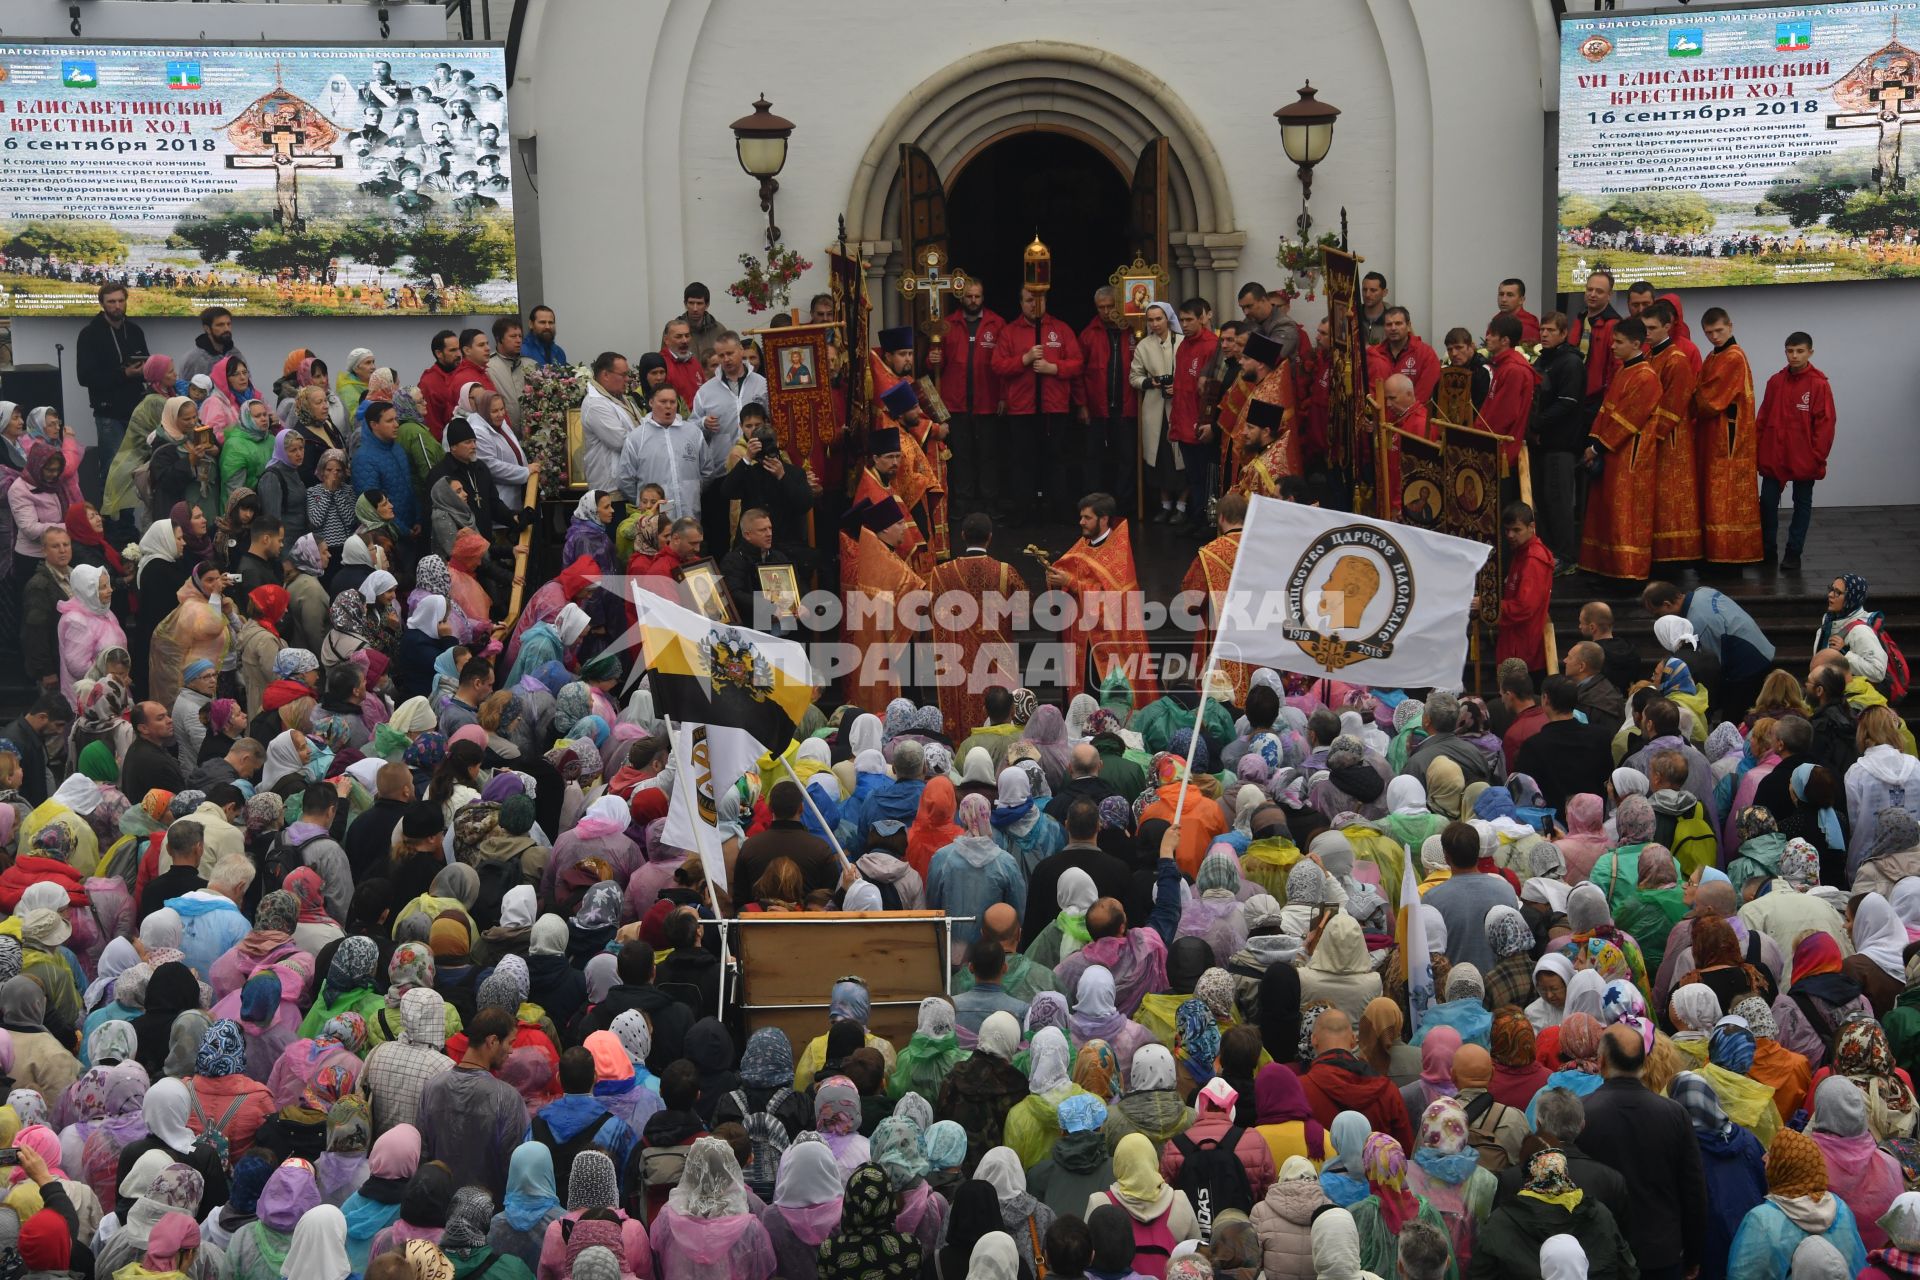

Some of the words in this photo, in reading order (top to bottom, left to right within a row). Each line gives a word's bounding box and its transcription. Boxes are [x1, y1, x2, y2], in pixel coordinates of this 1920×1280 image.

[1576, 22, 1594, 30] ПО
[1598, 15, 1716, 30] БЛАГОСЛОВЕНИЮ
[1720, 8, 1822, 23] МИТРОПОЛИТА
[1827, 2, 1918, 16] КРУТИЦКОГО
[111, 50, 209, 58] МИТРОПОЛИТА
[1618, 58, 1831, 87] ЕЛИСАВЕТИНСКИЙ
[1610, 83, 1734, 106] КРЕСТНЫЙ
[1746, 82, 1796, 100] ХОД
[17, 98, 222, 116] ЕЛИСАВЕТИНСКИЙ
[1588, 110, 1616, 124] 16
[1624, 104, 1746, 122] сентября
[1756, 100, 1820, 116] 2018
[10, 117, 132, 134] КРЕСТНЫЙ
[146, 120, 192, 135] ХОД
[1610, 130, 1664, 138] столетию
[1666, 124, 1750, 137] мученической
[1753, 124, 1806, 132] кончины
[27, 138, 148, 154] сентября
[156, 138, 216, 152] 2018
[1610, 144, 1732, 158] преподобномучениц
[1736, 140, 1785, 150] Великой
[1788, 139, 1838, 148] Княгини
[1636, 136, 1713, 148] Царственных
[70, 159, 152, 168] мученической
[1572, 158, 1634, 168] Елисаветы
[1636, 154, 1712, 166] Феодоровны
[1726, 152, 1776, 160] инокини
[1780, 149, 1832, 158] Варвары
[1668, 162, 1735, 172] Алапаевске
[1738, 160, 1796, 170] убиенных
[41, 168, 118, 176] Царственных
[1654, 172, 1747, 182] представителей
[17, 177, 138, 186] преподобномучениц
[1601, 182, 1696, 194] Императорского
[1700, 180, 1730, 190] Дома
[1734, 177, 1802, 187] Романовых
[44, 186, 118, 194] Феодоровны
[12, 212, 106, 220] Императорского
[109, 212, 140, 220] Дома
[64, 204, 154, 212] представителей
[1290, 544, 1325, 620] ОБЩЕСТВО
[1330, 531, 1396, 556] ЦАРСКОЕ
[1378, 562, 1410, 641] НАСЛЕДИЕ
[1288, 630, 1311, 641] 1918
[1358, 644, 1384, 658] 2018
[1197, 1187, 1212, 1245] DIDAS
